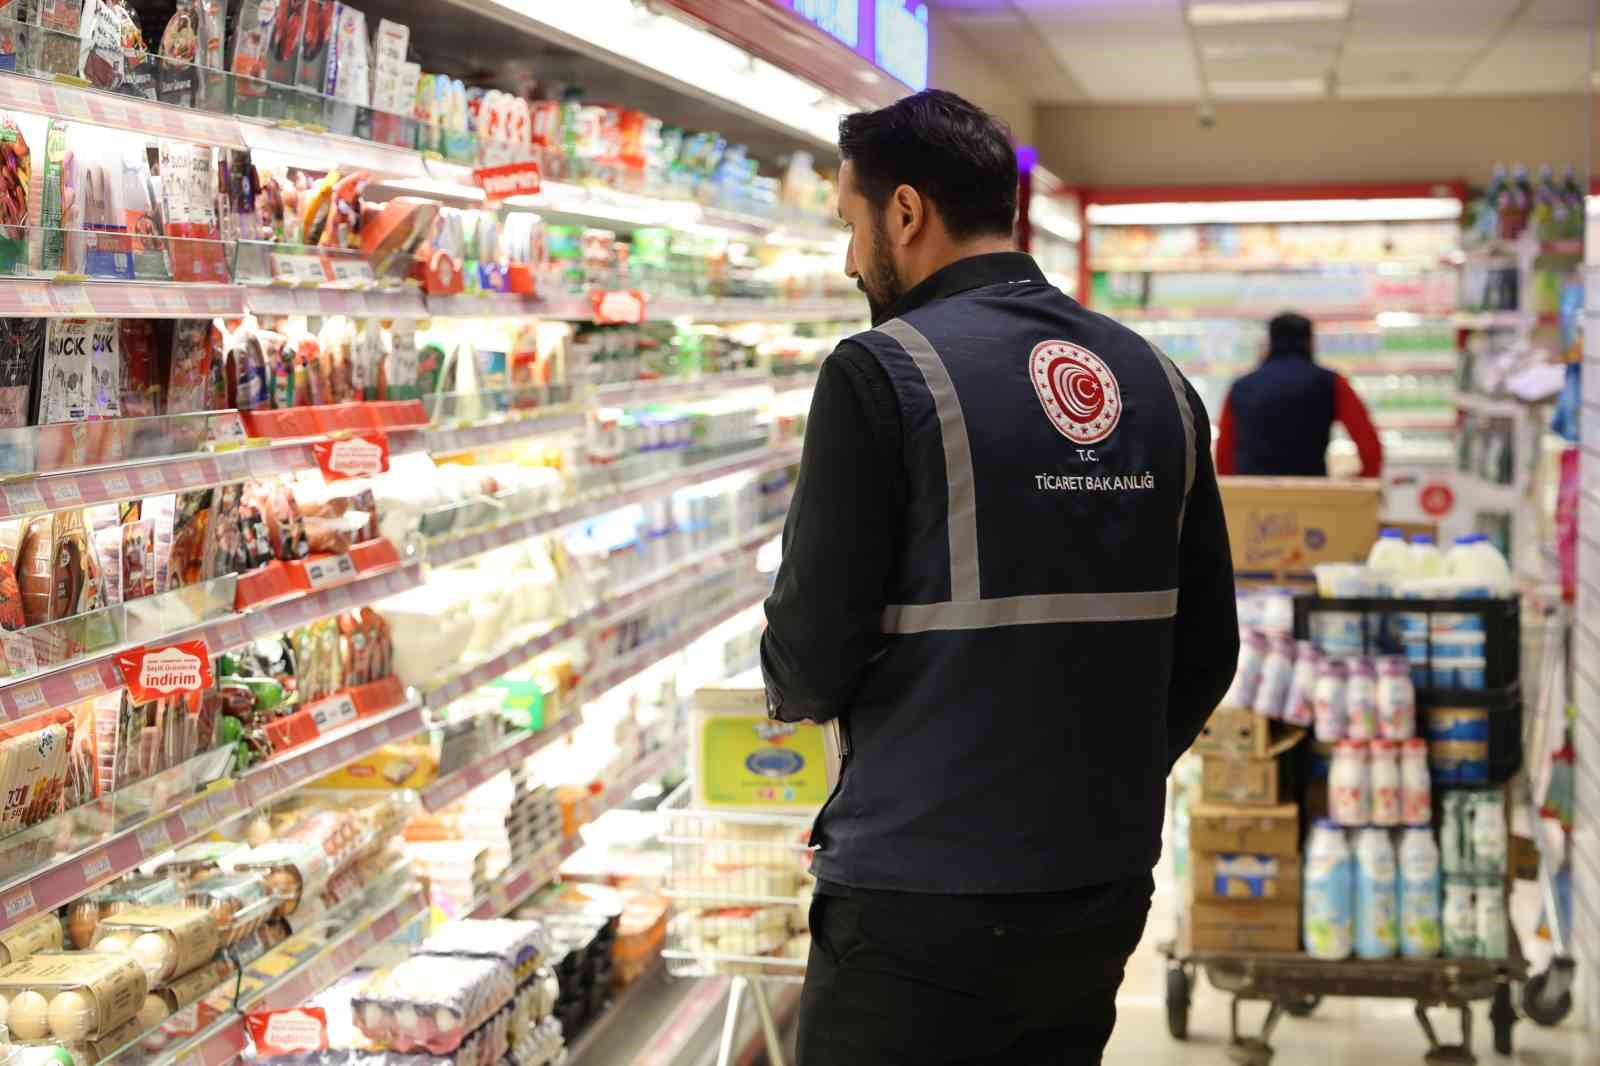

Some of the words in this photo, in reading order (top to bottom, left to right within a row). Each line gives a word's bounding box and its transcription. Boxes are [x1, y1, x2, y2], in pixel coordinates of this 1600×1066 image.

[1076, 450, 1099, 461] T.C.
[1035, 473, 1084, 490] TİCARET
[1086, 472, 1154, 490] BAKANLIĞI
[146, 673, 196, 685] indirim
